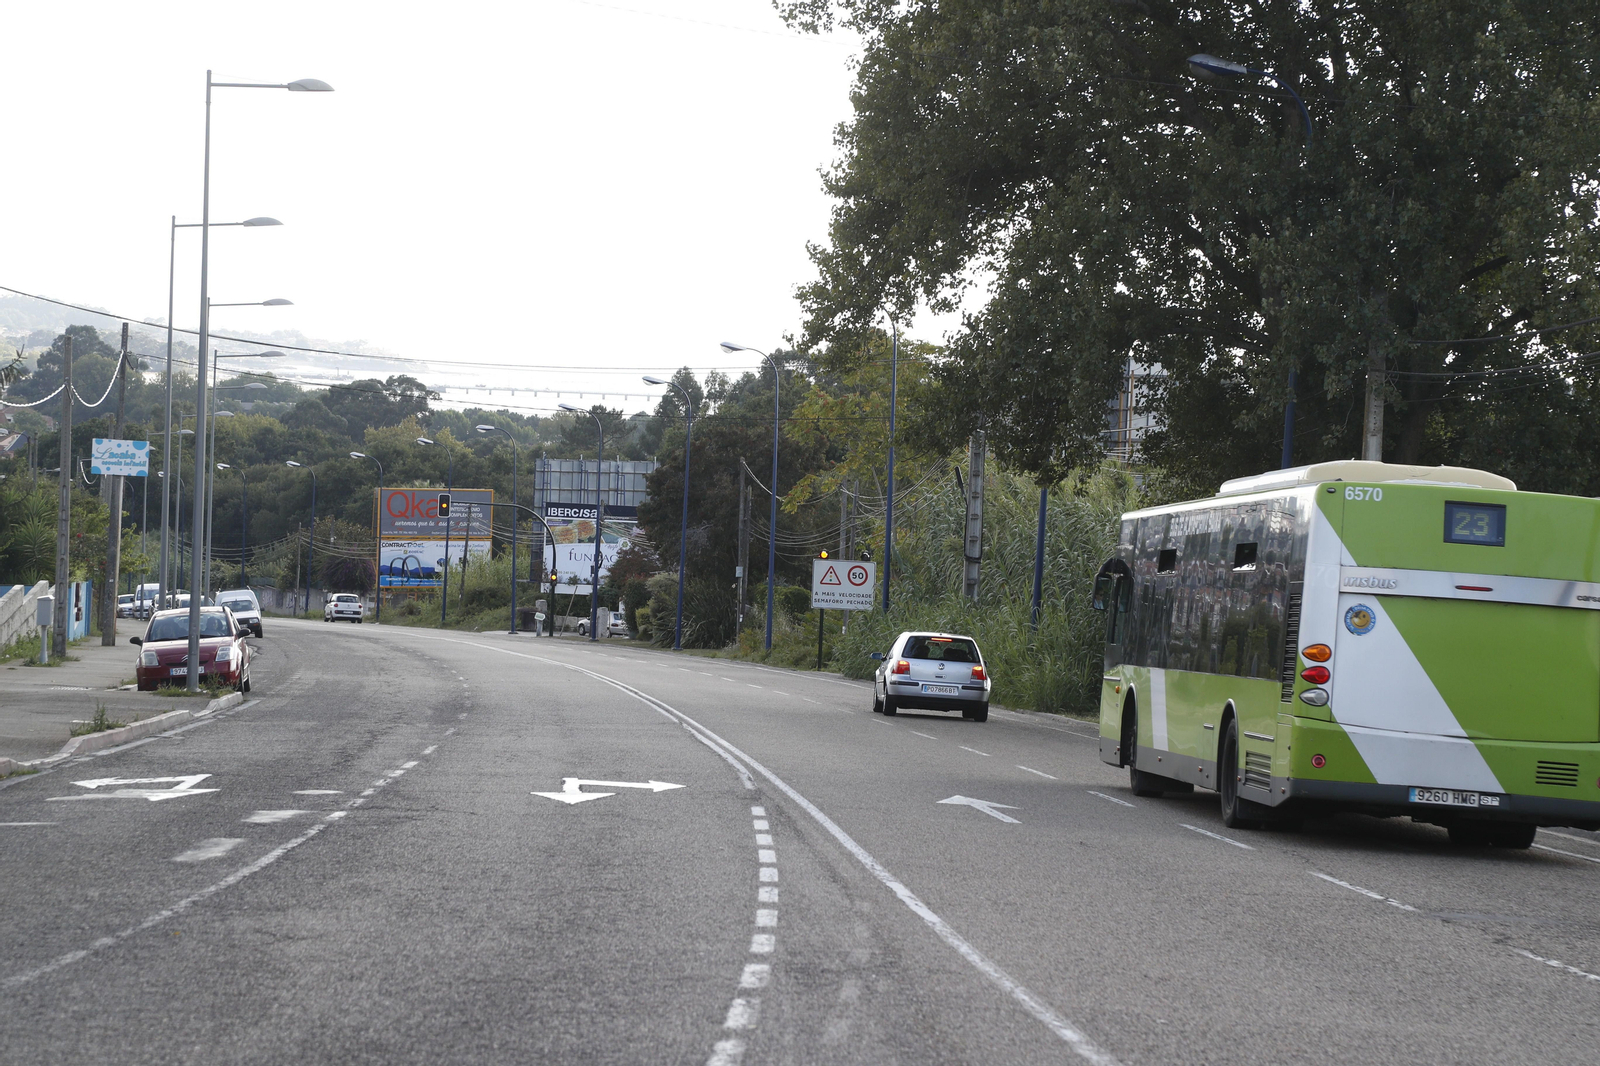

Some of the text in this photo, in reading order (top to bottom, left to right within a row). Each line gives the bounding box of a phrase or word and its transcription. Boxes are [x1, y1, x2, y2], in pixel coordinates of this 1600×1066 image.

[1344, 486, 1383, 502] 6570
[1454, 511, 1490, 537] 23
[851, 572, 864, 580] 50
[1417, 789, 1449, 803] 9260
[1452, 792, 1476, 805] HMG
